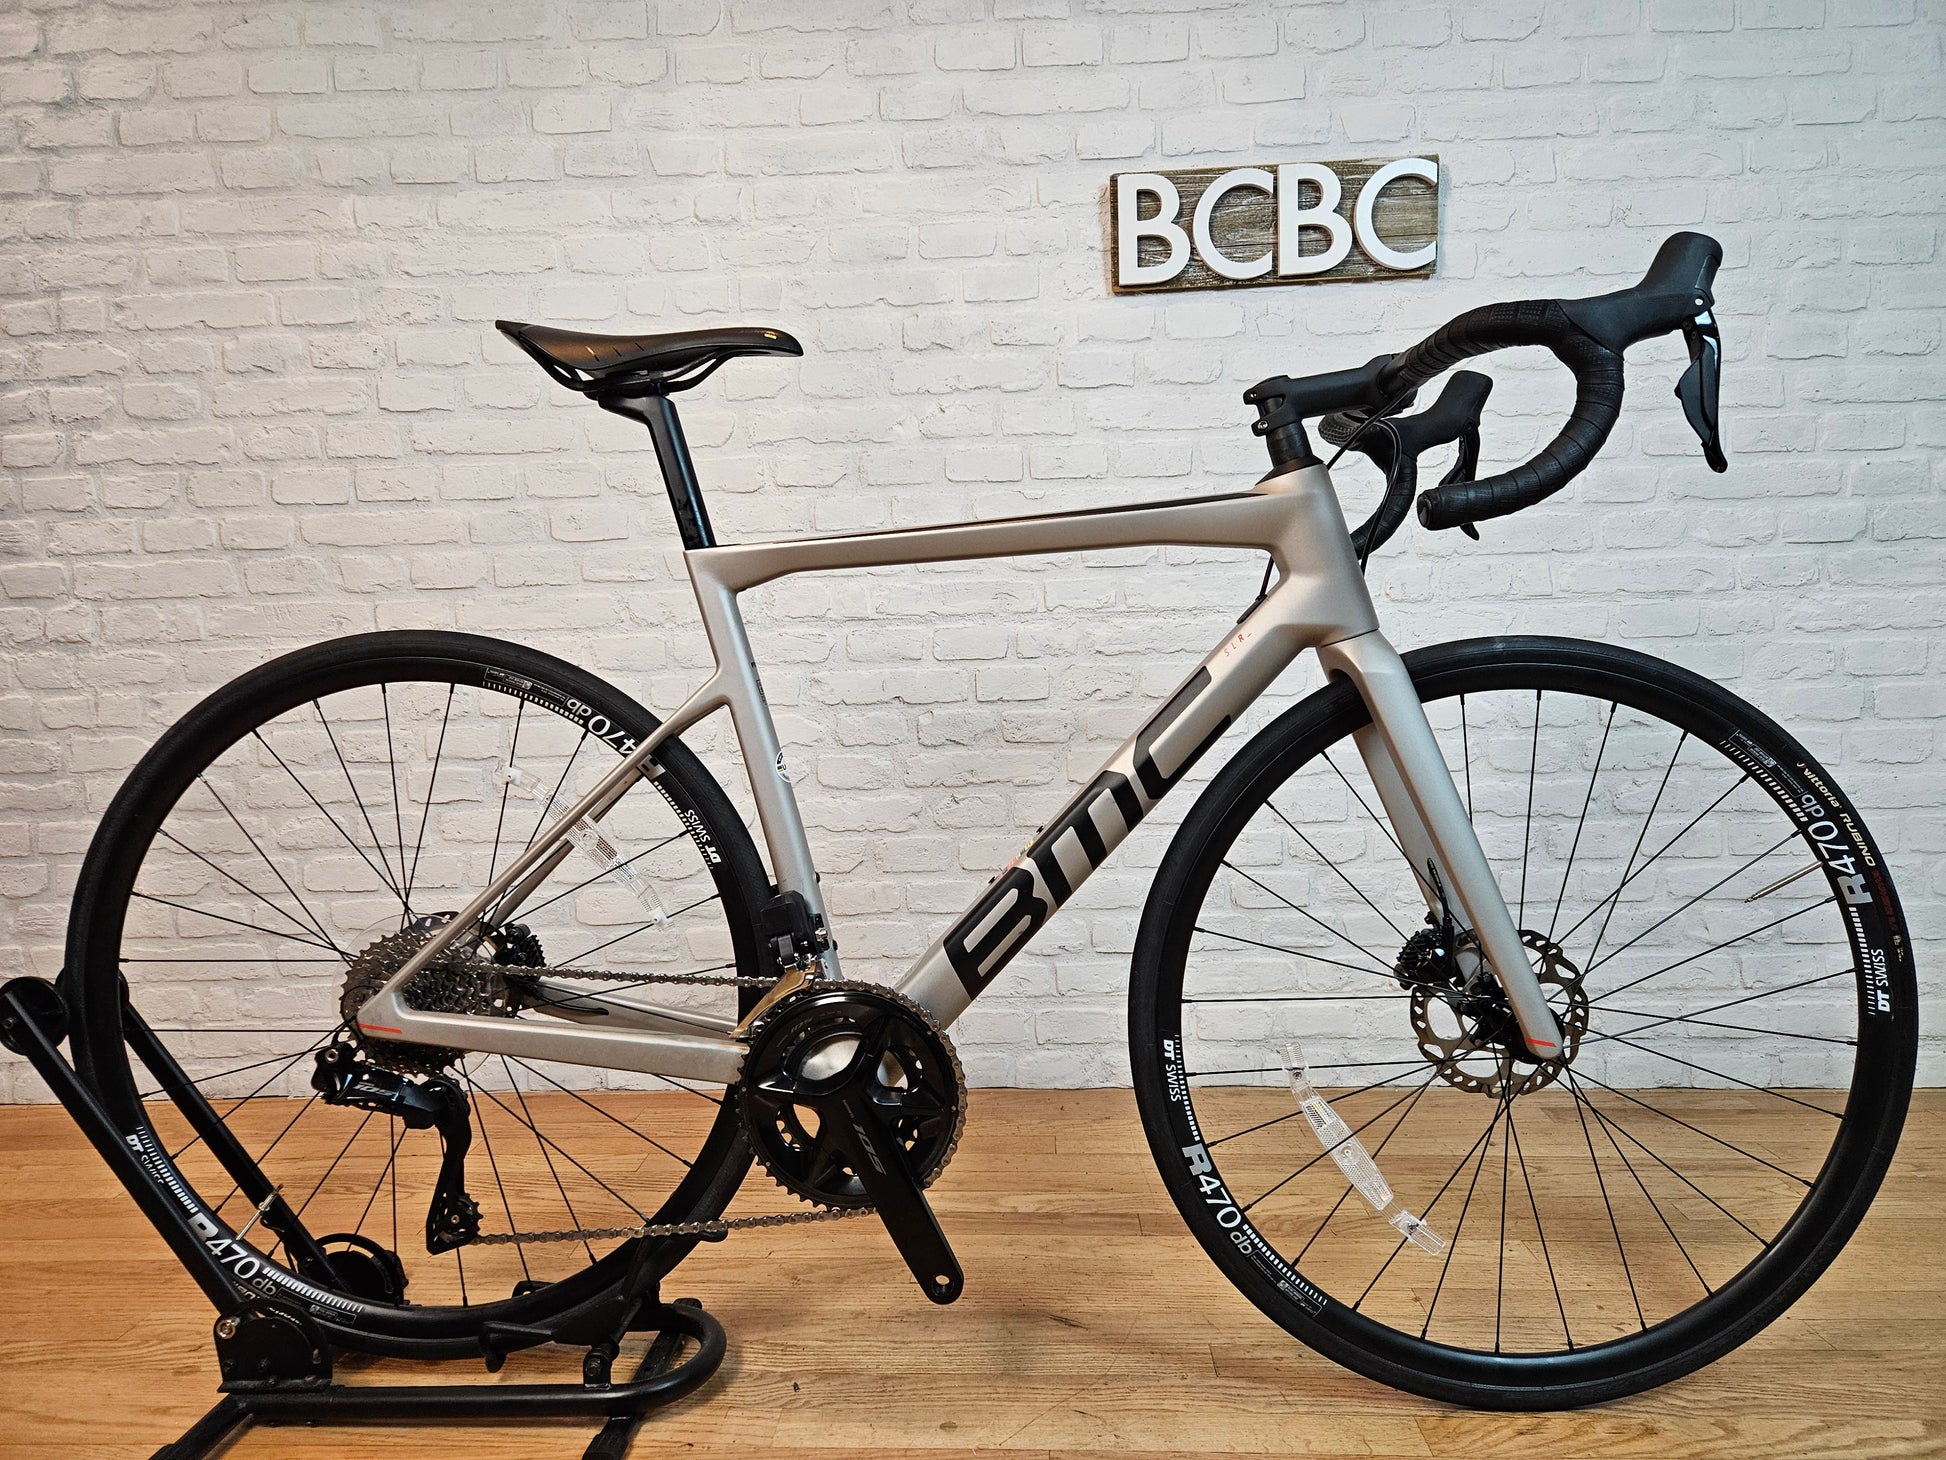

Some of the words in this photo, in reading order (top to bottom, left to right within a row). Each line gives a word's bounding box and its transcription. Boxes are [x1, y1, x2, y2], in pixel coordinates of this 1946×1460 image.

[1117, 158, 1438, 286] BCBC
[566, 698, 592, 717] db
[1800, 790, 1825, 818] db
[684, 808, 711, 844] SWISS
[943, 665, 1232, 1002] BMC
[1839, 812, 1876, 867] RUBINO
[707, 844, 722, 865] DT
[1807, 820, 1873, 906] R470
[1871, 948, 1889, 988] SWISS
[1877, 990, 1891, 1012] DT
[1163, 1038, 1175, 1061] DT
[1165, 1063, 1182, 1102] SWISS
[125, 1134, 144, 1152] DT
[852, 1122, 887, 1175] 105
[1182, 1142, 1242, 1228] R470
[1230, 1230, 1252, 1255] db
[252, 1278, 277, 1295] db
